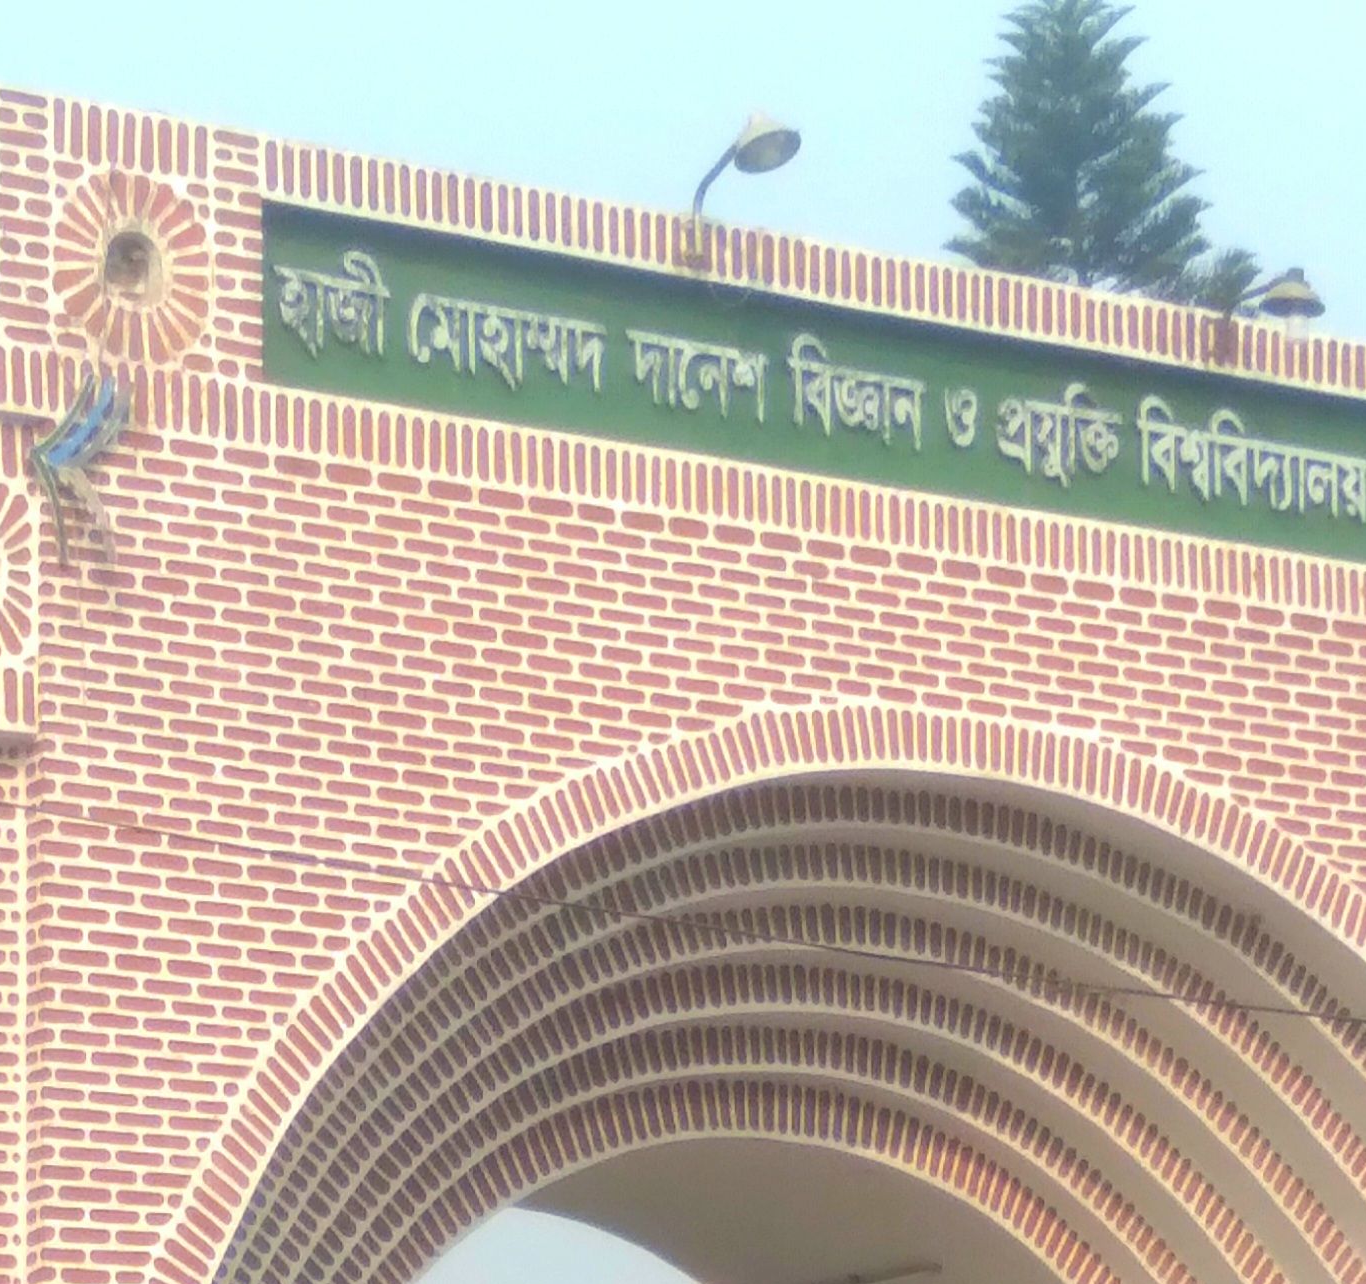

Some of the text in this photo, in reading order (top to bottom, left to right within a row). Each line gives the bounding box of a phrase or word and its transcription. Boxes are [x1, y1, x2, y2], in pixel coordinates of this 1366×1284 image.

[274, 248, 391, 359] হাজী
[407, 292, 607, 392] মোহাম্মদ
[626, 327, 769, 425] দানেশ
[787, 332, 926, 451] বিজ্ঞান
[944, 386, 978, 446] ও
[997, 382, 1121, 487] প্রযুক্তি
